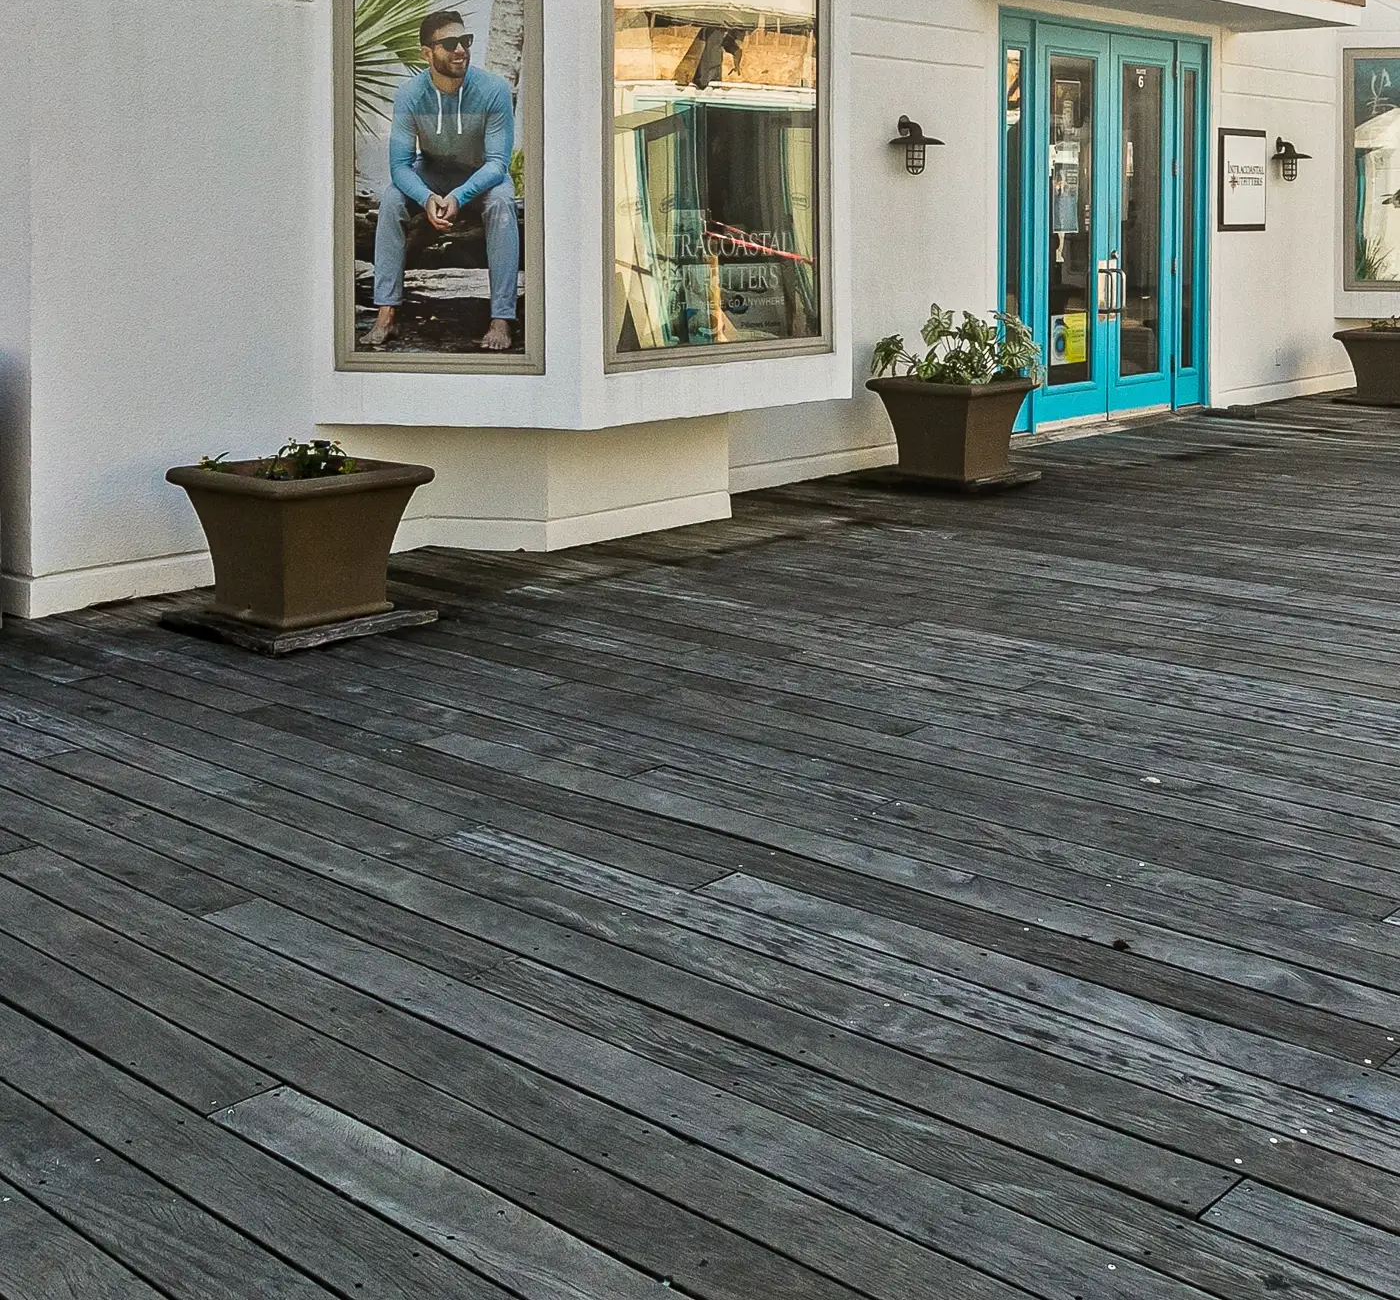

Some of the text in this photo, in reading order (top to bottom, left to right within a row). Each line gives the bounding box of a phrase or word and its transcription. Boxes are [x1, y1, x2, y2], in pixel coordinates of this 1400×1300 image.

[1138, 75, 1144, 88] 6
[728, 299, 740, 309] GO
[742, 295, 785, 307] ANYWHERE
